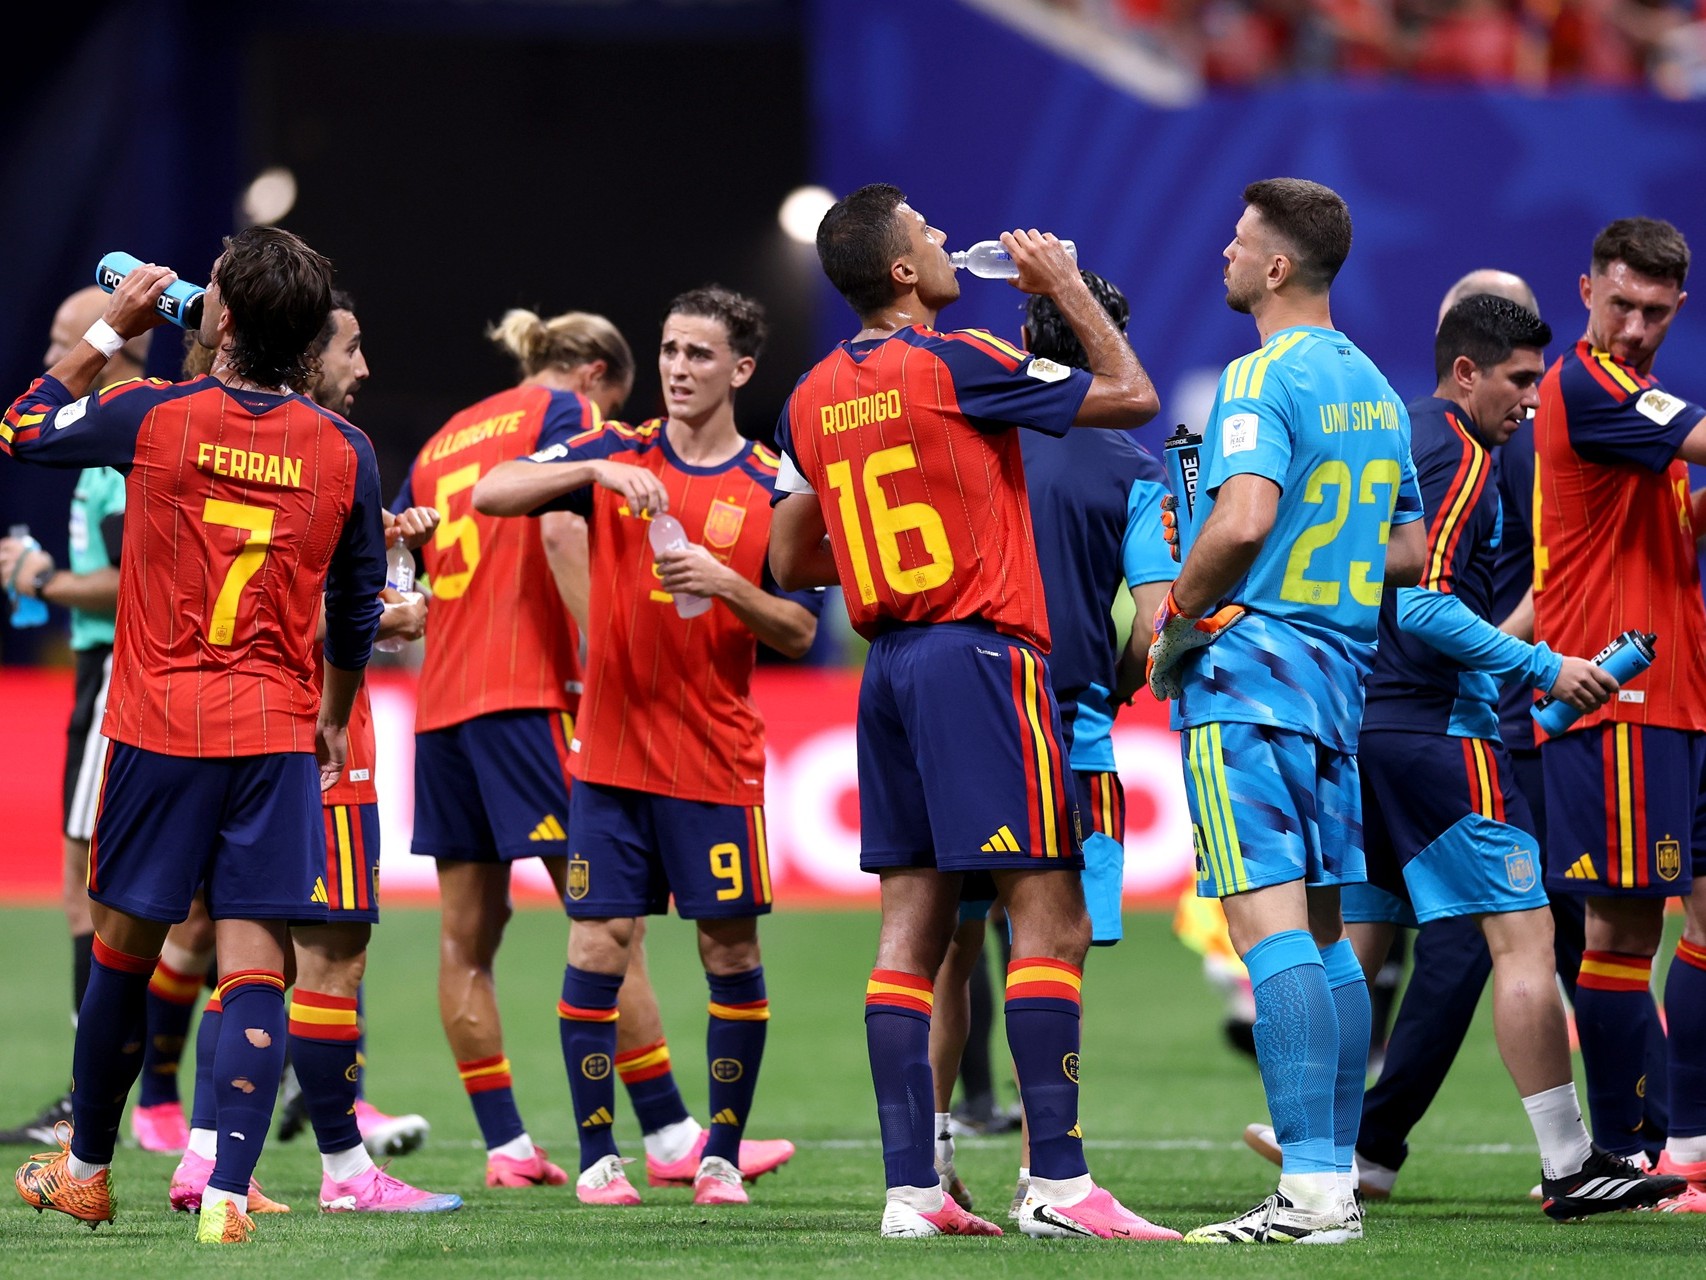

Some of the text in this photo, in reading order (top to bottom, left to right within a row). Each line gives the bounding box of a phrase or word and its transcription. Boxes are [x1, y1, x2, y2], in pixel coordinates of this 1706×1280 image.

[104, 270, 174, 314] PODE
[820, 388, 902, 436] RODRIGO
[198, 442, 303, 489] FERRAN
[202, 498, 276, 646] 7
[433, 462, 481, 601] 5
[825, 443, 954, 606] 16
[1279, 458, 1402, 606] 23
[710, 842, 743, 901] 9
